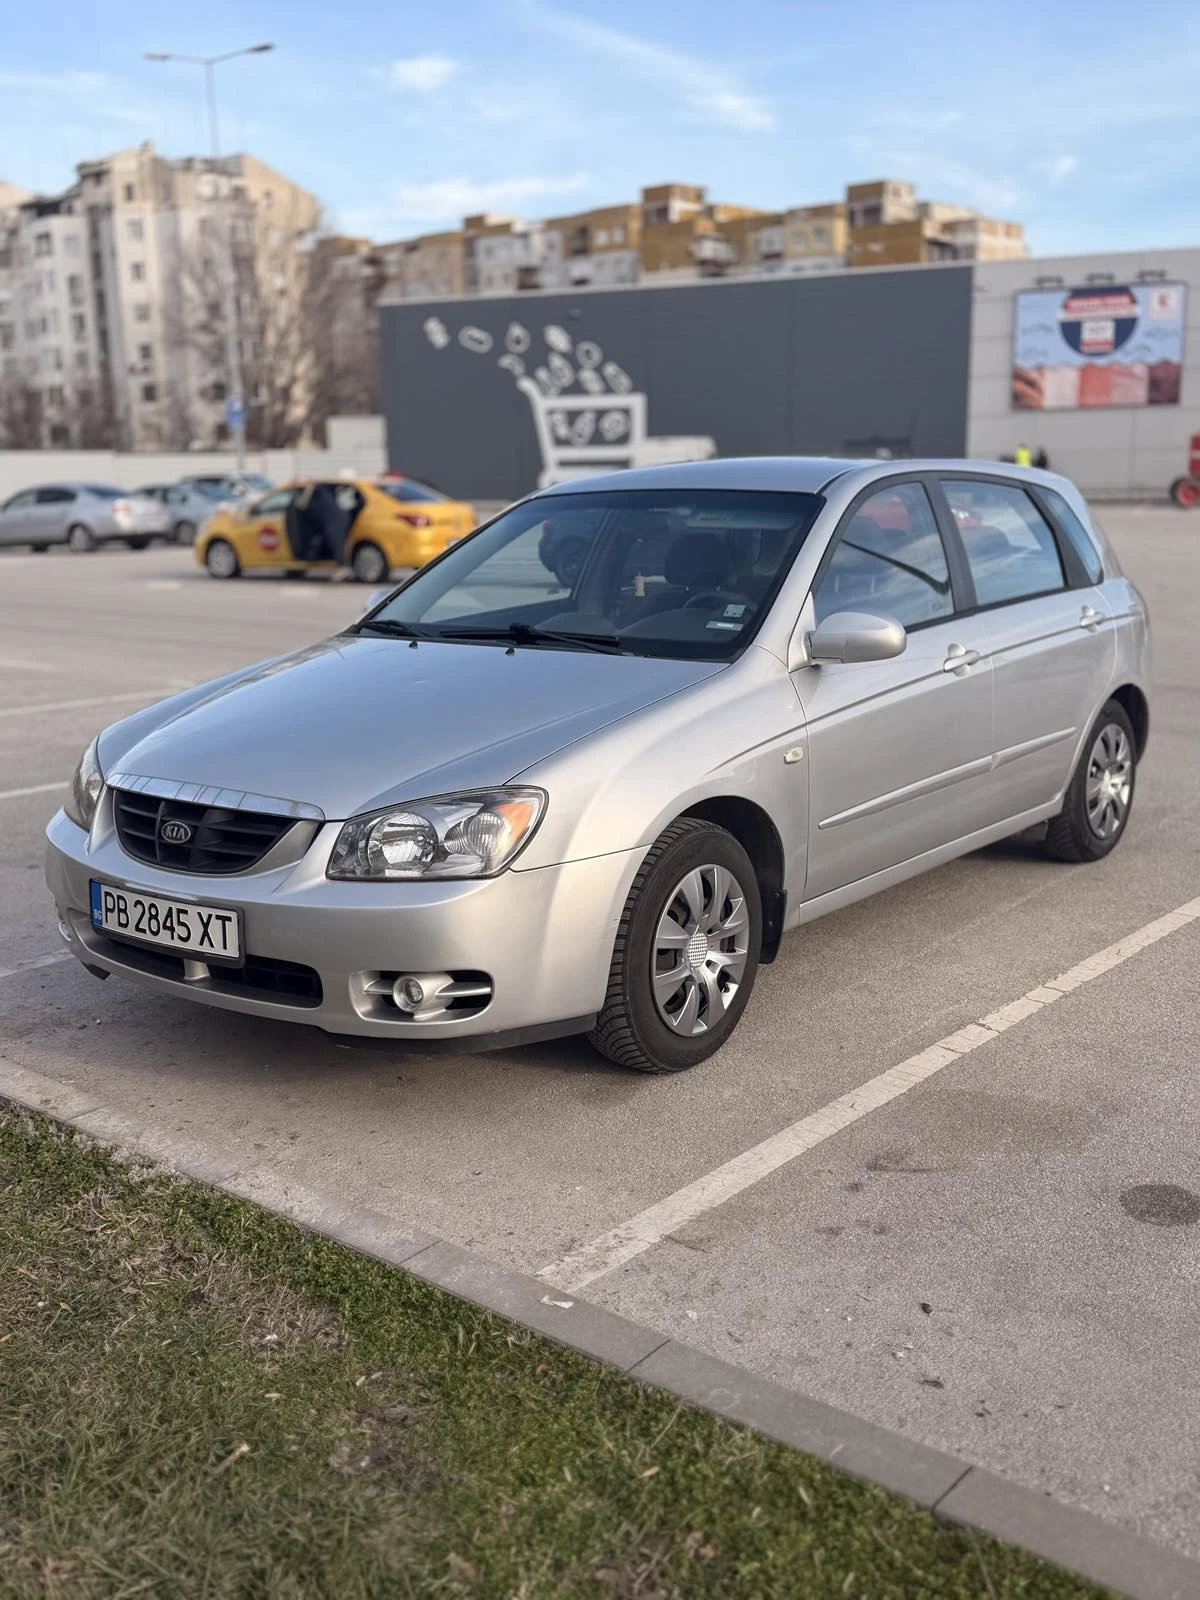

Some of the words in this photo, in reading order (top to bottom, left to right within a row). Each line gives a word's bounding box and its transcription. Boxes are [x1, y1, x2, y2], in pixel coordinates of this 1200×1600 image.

[165, 825, 186, 840] KIA
[104, 891, 130, 929] PB
[133, 899, 192, 943] 2845
[197, 911, 232, 950] XT
